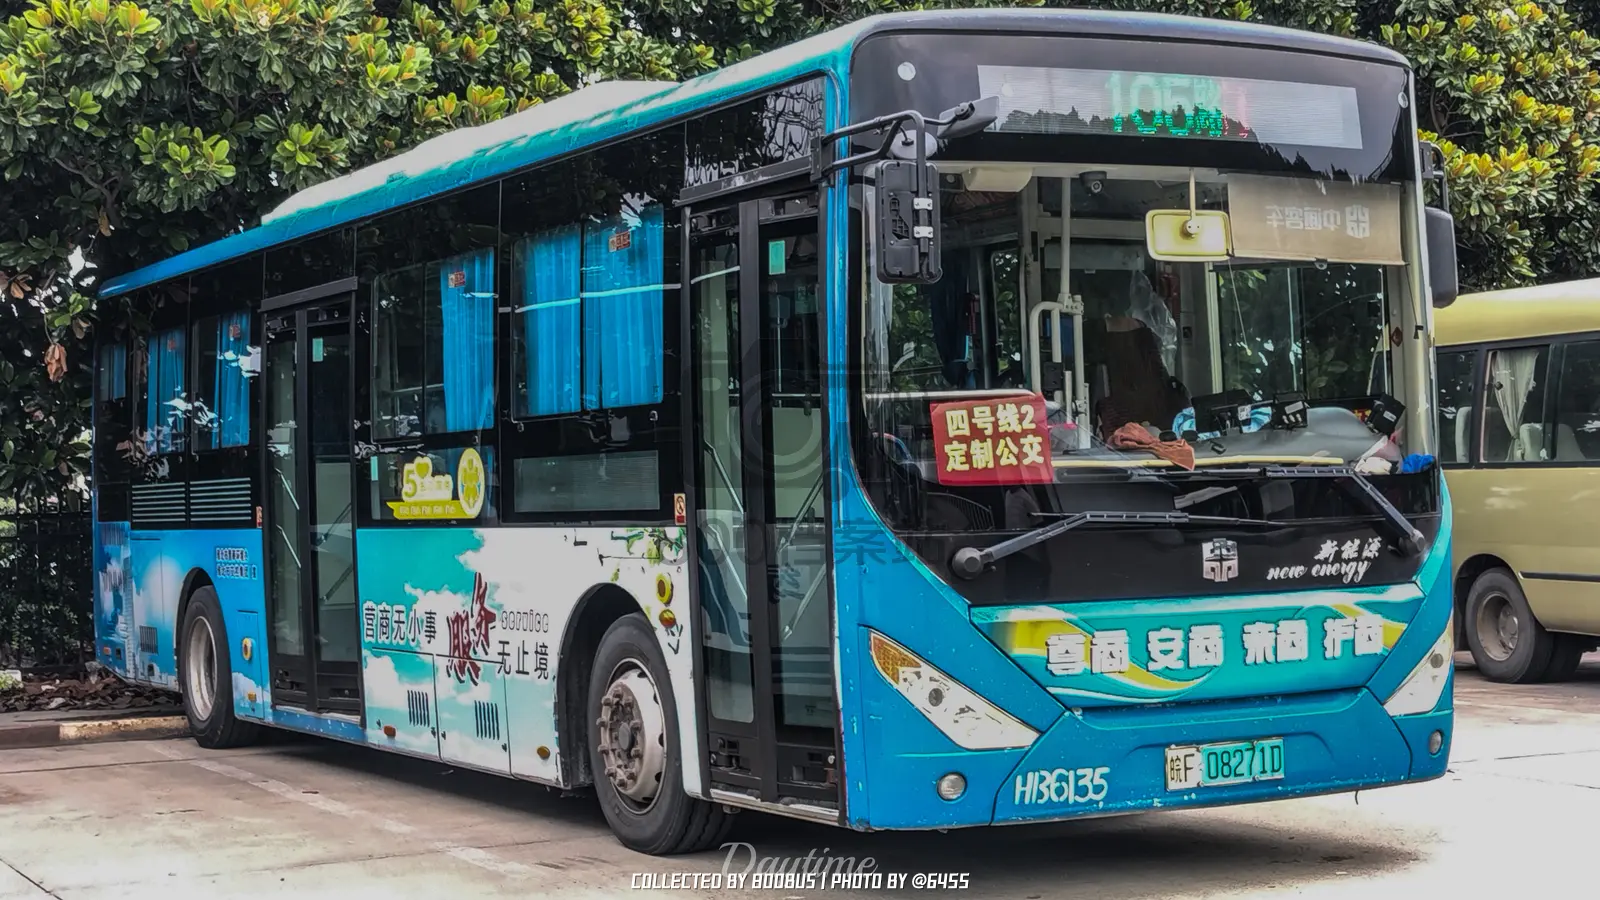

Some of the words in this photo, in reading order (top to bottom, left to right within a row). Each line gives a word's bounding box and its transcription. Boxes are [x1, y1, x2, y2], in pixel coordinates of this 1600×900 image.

[945, 403, 1037, 438] 四号线2
[944, 434, 1045, 472] 定制公交
[1314, 536, 1383, 562] 新能源
[1266, 566, 1308, 580] new
[1311, 561, 1372, 583] energy
[363, 605, 437, 645] 营商无小事
[497, 639, 549, 680] 无止境
[1046, 630, 1129, 676] 尊商
[1147, 625, 1223, 671] 安商
[1323, 614, 1383, 659] 护商
[1169, 752, 1196, 783] 皖F
[1207, 744, 1283, 780] 08271D
